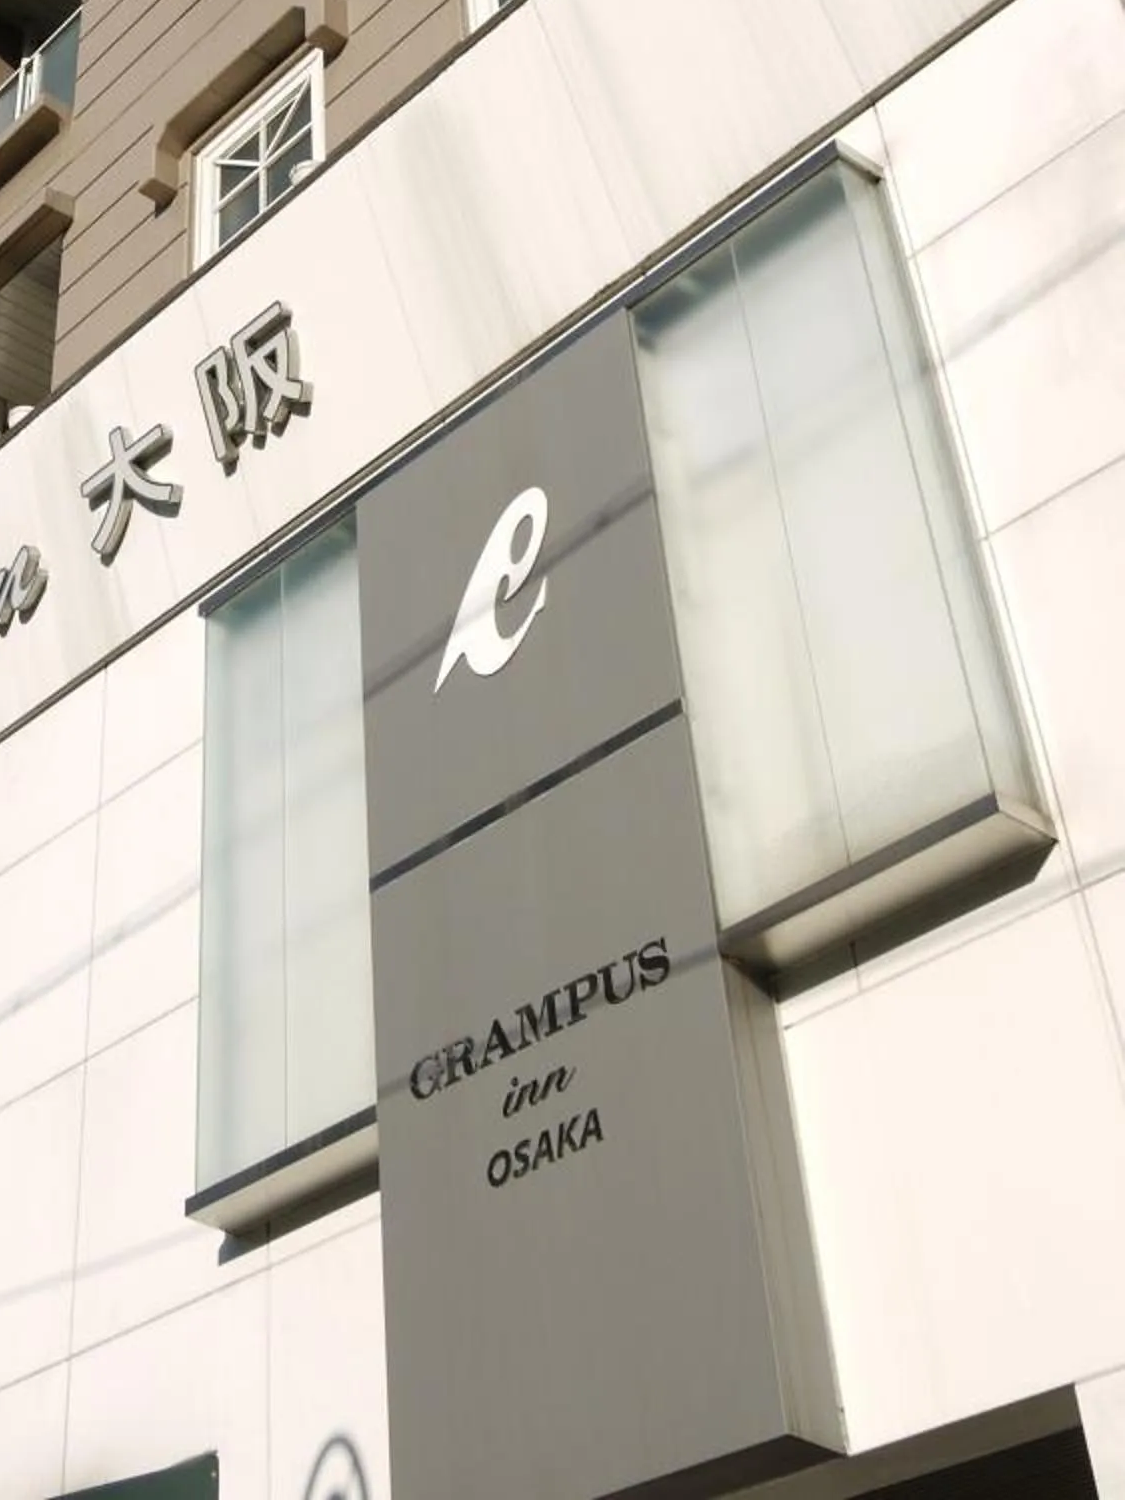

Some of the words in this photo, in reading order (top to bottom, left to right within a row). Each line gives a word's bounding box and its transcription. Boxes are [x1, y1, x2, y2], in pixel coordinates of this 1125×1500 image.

[79, 299, 316, 568] 大阪
[408, 936, 671, 1101] GRAMPUS
[486, 1107, 605, 1189] OSAKA
[501, 1064, 578, 1119] inn
